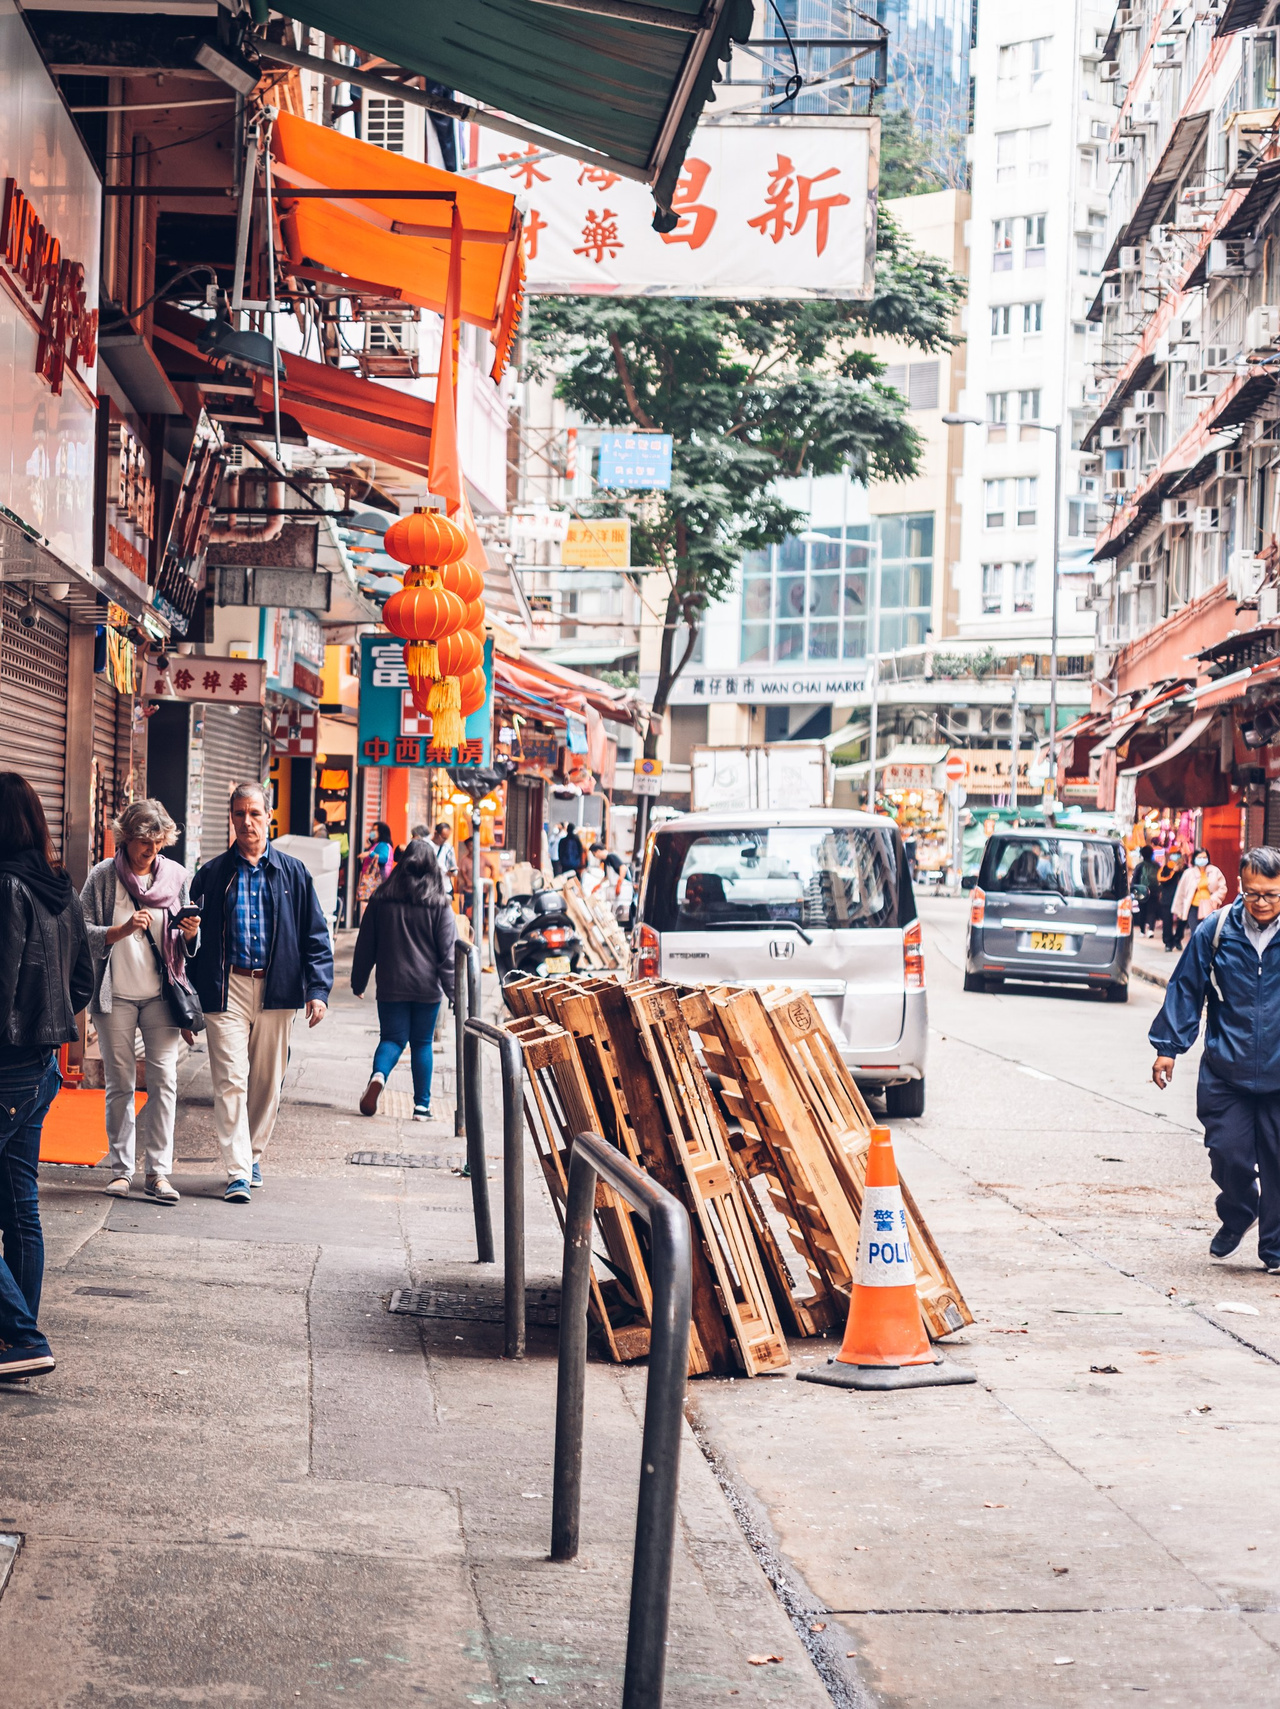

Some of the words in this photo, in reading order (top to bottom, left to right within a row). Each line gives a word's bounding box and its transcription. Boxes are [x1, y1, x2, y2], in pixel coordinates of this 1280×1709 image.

[693, 677, 755, 695] 灣仔街市
[761, 682, 789, 694] WAN
[792, 681, 821, 694] CHAI
[791, 1003, 810, 1028] EPAL
